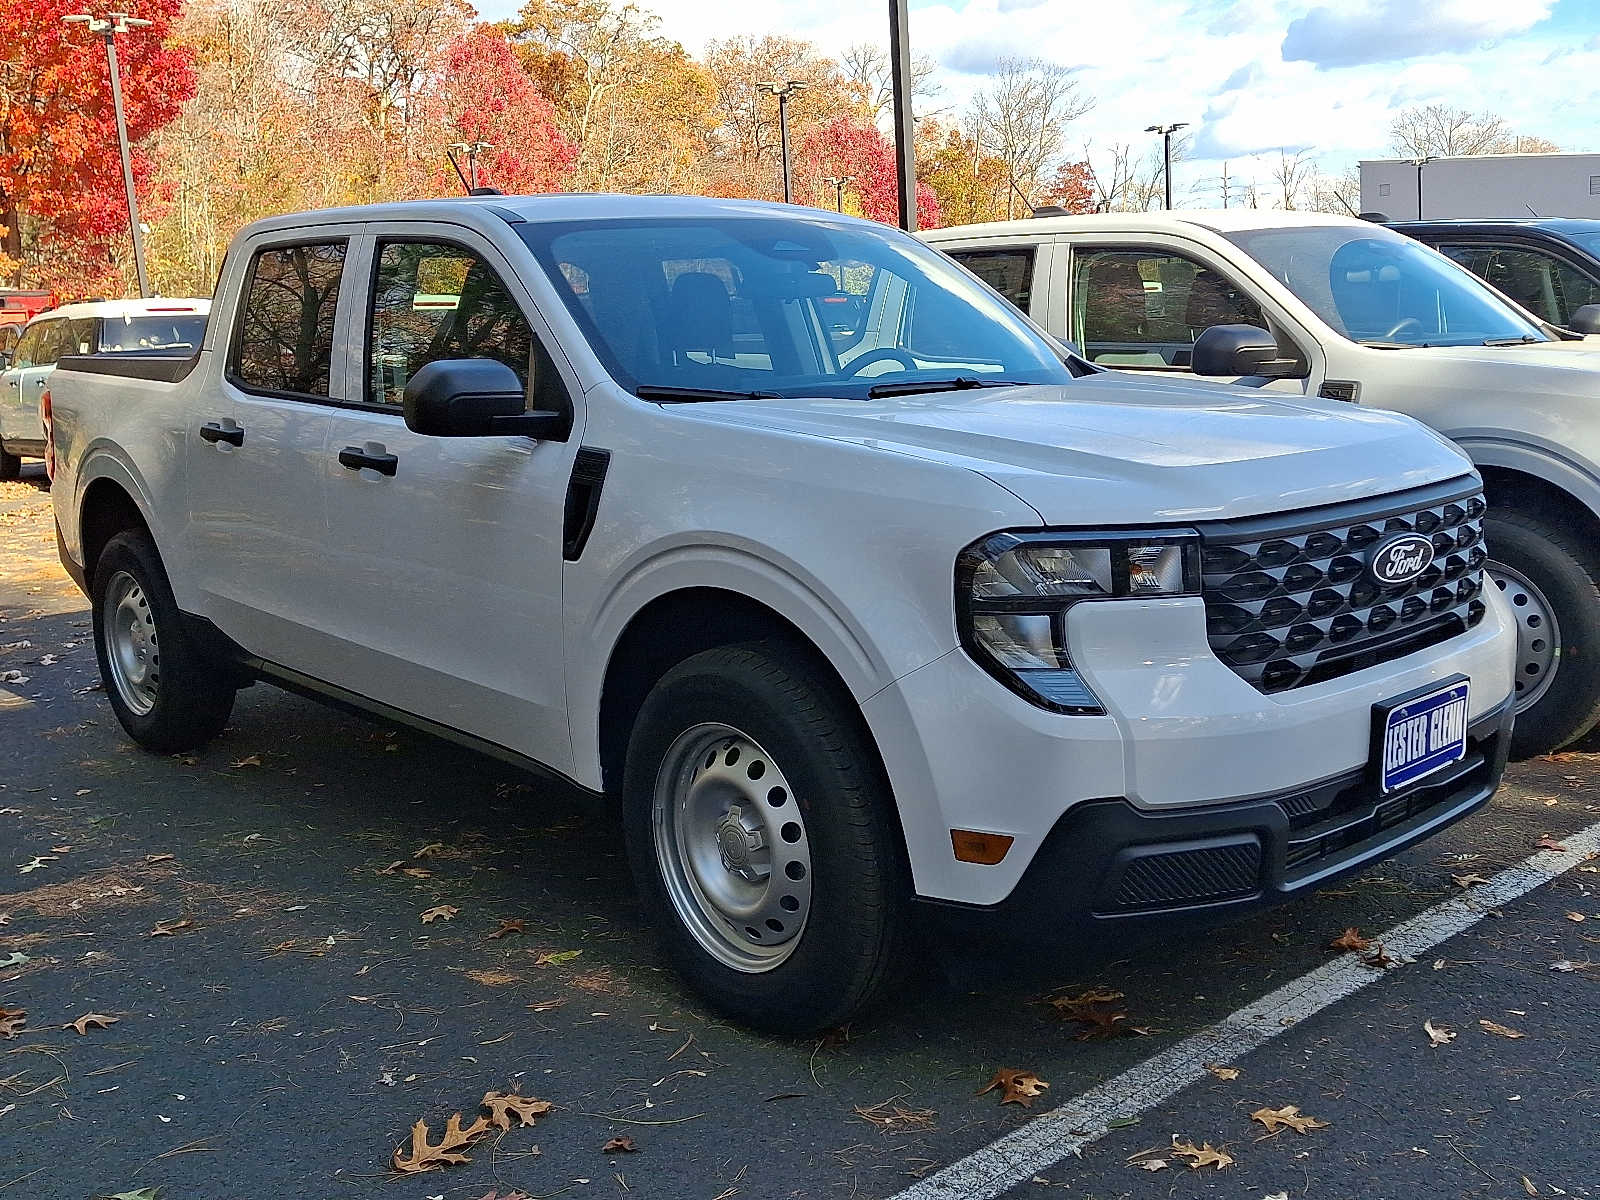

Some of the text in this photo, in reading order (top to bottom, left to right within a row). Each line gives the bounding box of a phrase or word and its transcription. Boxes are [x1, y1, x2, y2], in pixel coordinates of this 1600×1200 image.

[1385, 544, 1424, 577] Ford
[1386, 699, 1465, 772] LESTER GLENN
